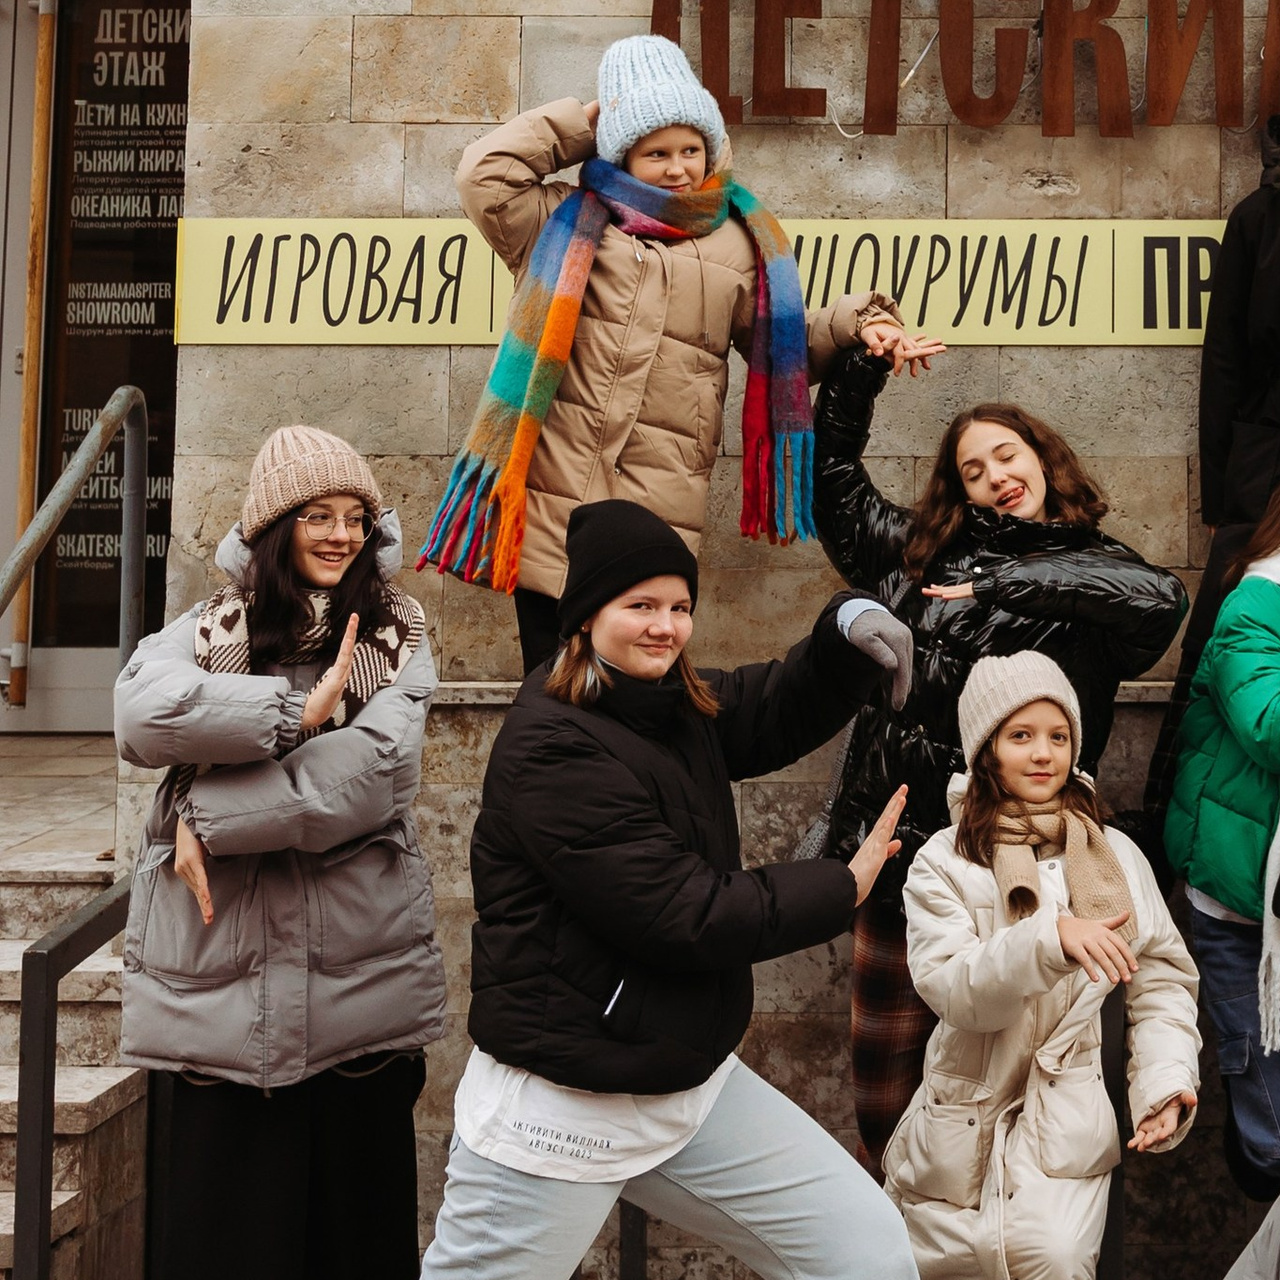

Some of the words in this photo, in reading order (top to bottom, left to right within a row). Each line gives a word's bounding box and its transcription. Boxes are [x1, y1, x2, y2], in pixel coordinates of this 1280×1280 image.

[94, 8, 191, 43] ДЕТСКИ
[93, 52, 166, 86] ЭТАЖ
[74, 102, 116, 126] ДЕТИ
[120, 104, 141, 126] НА
[146, 104, 187, 126] КУХН
[138, 149, 185, 173] ЖИРА
[70, 195, 152, 218] ОКЕАНИКА
[123, 220, 177, 229] робототехн
[67, 282, 172, 299] INSTAMAMASPITER
[215, 232, 468, 327] ИГРОВАЯ
[66, 302, 156, 324] SHOWROOM
[569, 1147, 592, 1160] 2023
